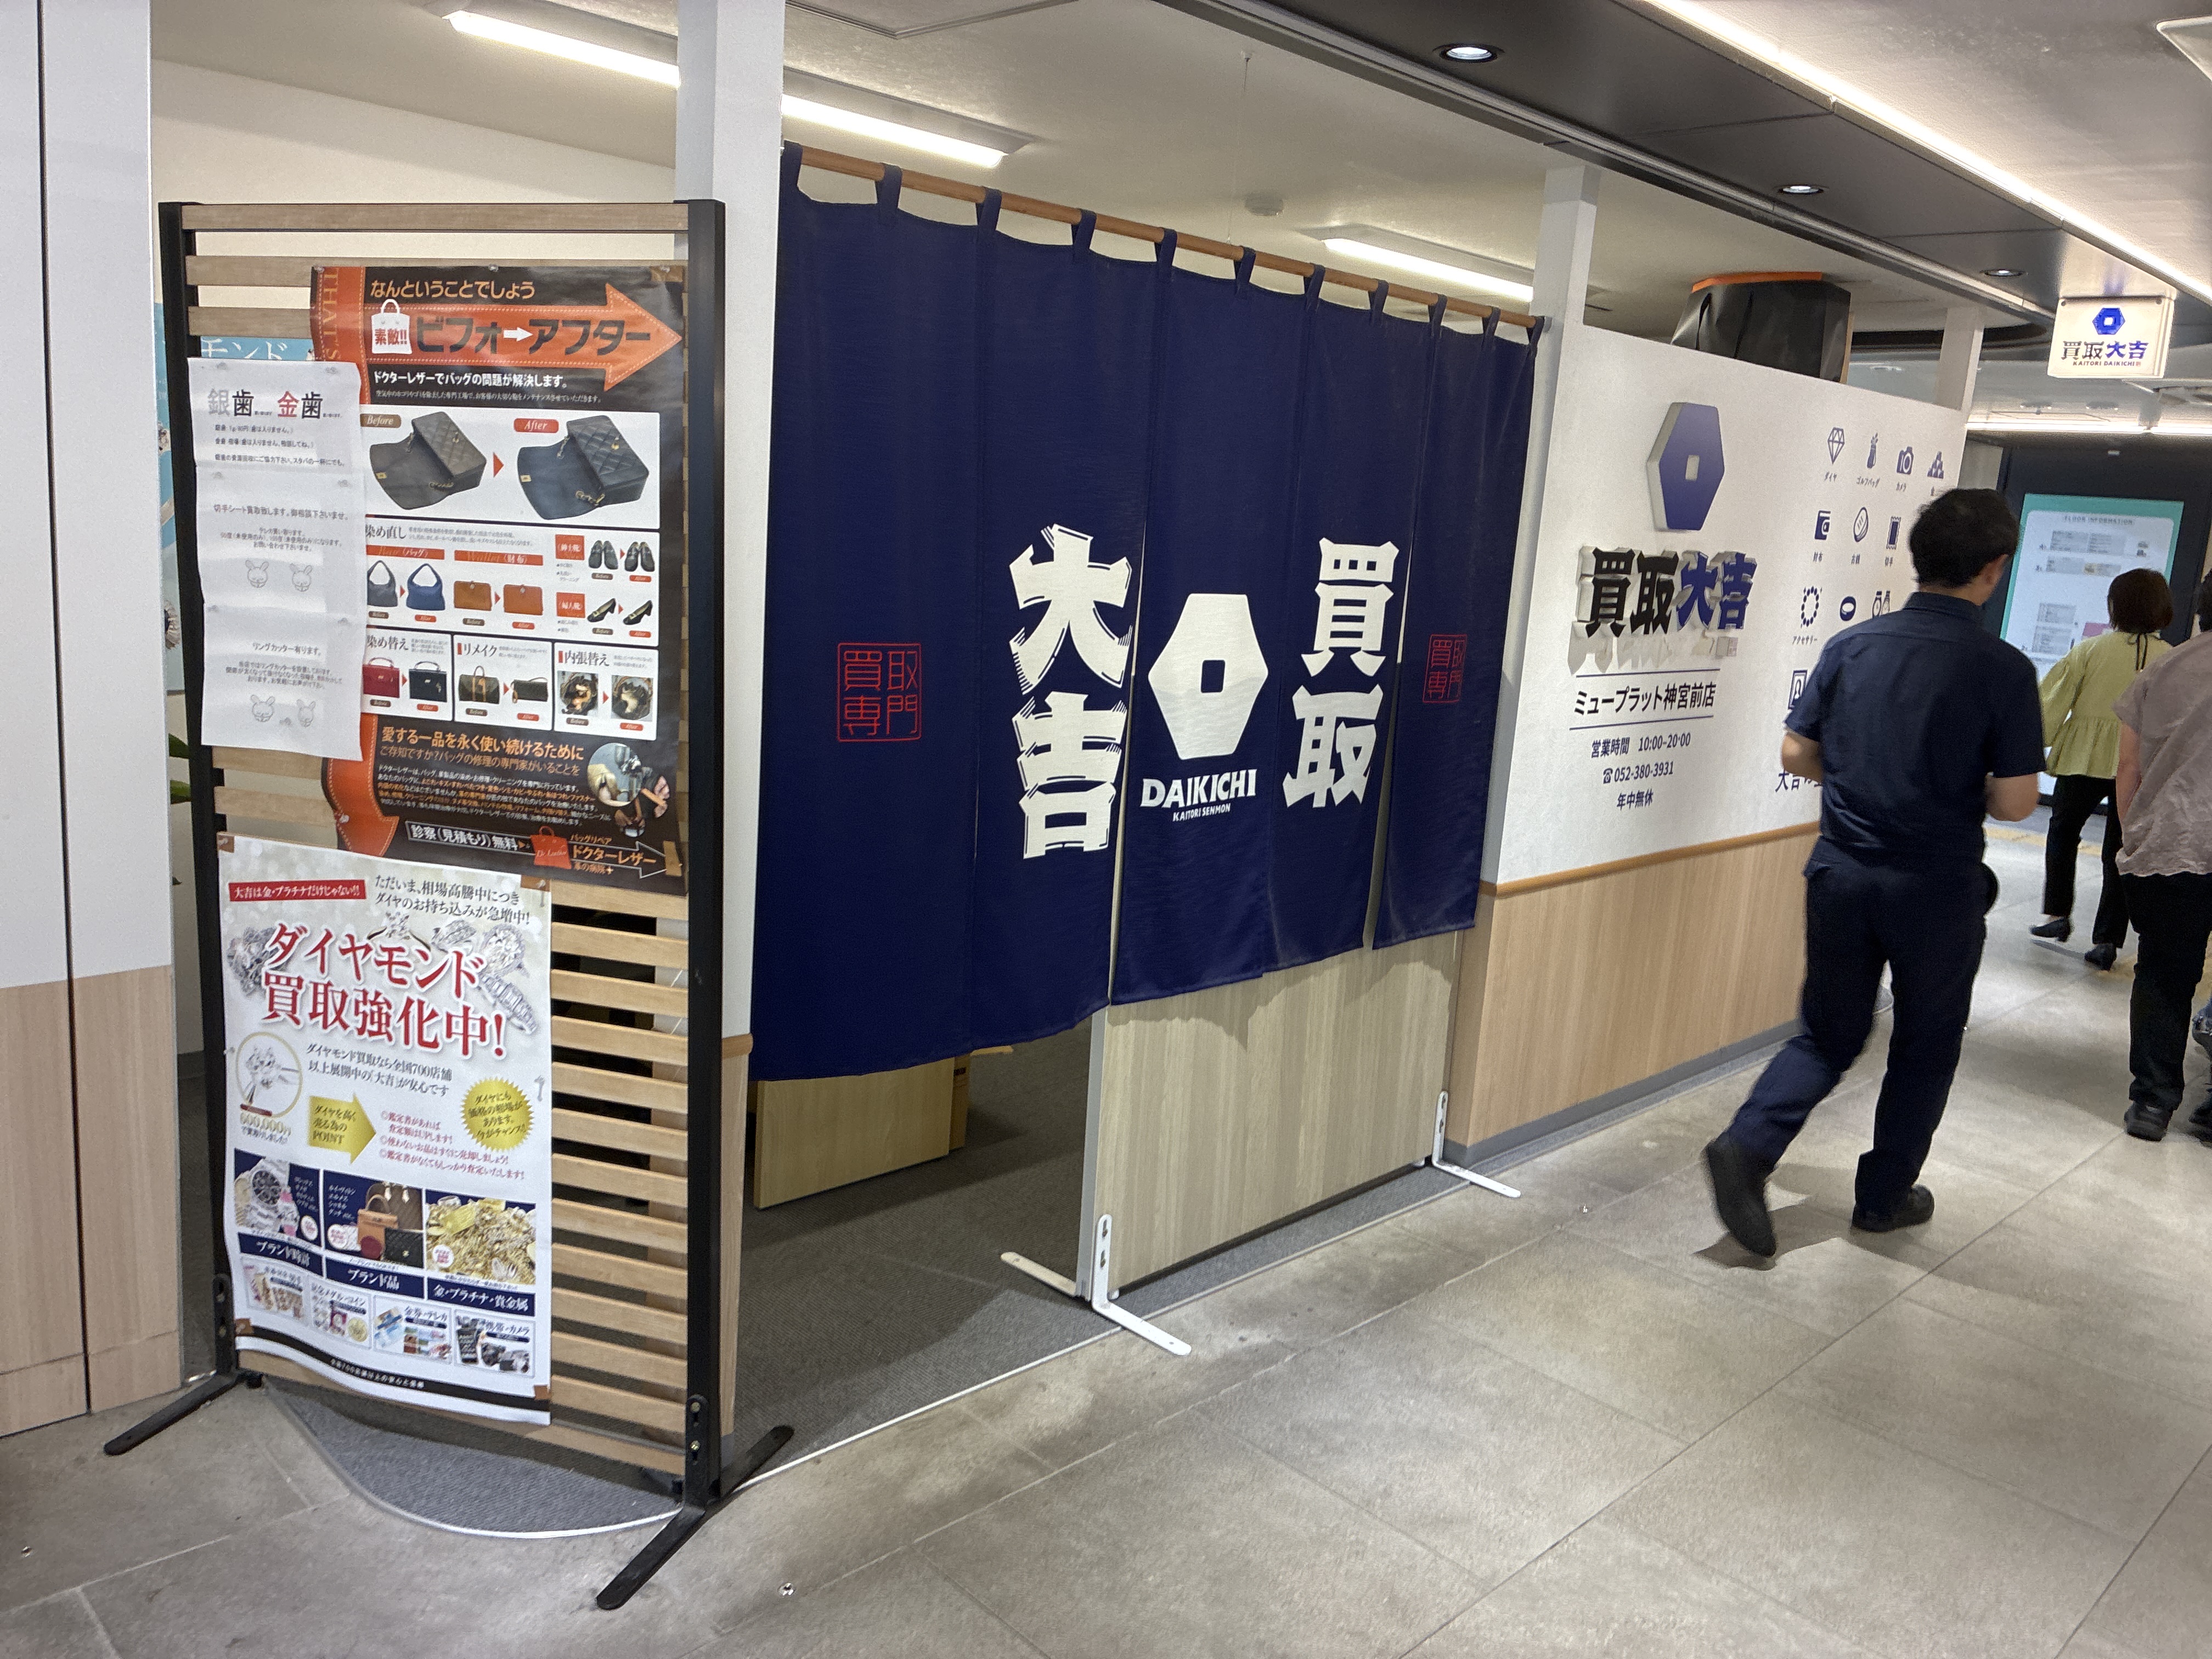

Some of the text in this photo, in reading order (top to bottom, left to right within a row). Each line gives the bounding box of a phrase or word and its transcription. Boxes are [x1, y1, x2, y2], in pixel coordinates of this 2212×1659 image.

[370, 280, 535, 299] なんということでしょう
[528, 319, 651, 356] アフター
[2061, 340, 2149, 360] 買取大吉
[374, 370, 568, 389] ドクターレザーでバッグの問題が解決します。
[207, 388, 255, 416] 銀歯
[277, 390, 324, 419] 金歯
[366, 415, 394, 427] Before
[523, 420, 549, 431] After
[366, 524, 407, 540] 染め直し
[1584, 547, 1757, 638] 買取大吉
[366, 634, 409, 651] 染め替え
[463, 643, 497, 657] リメイク
[565, 650, 610, 667] 内張替え
[1282, 537, 1400, 808] 買取
[1009, 523, 1133, 860] 大吉
[1574, 681, 1717, 715] ミュープラット神宮前店
[381, 726, 584, 760] 愛する一品を永く使い続けるために
[1591, 736, 1631, 758] 営業時間
[1614, 761, 1674, 783] 052-380-3931
[1139, 769, 1258, 809] DAIKICHI
[1616, 788, 1654, 811] 年中無休
[1172, 802, 1232, 822] KAITORI SENMON
[410, 823, 518, 851] 診察(見積もり)無料
[572, 845, 657, 866] ドクターレザー
[375, 874, 520, 906] ただいま、相場高騰中につき
[375, 892, 530, 925] ダイヤのお持ち込みが急増中!
[266, 923, 486, 999] ダイヤモンド
[262, 973, 505, 1057] 買取強化中!
[312, 1130, 345, 1145] POINT
